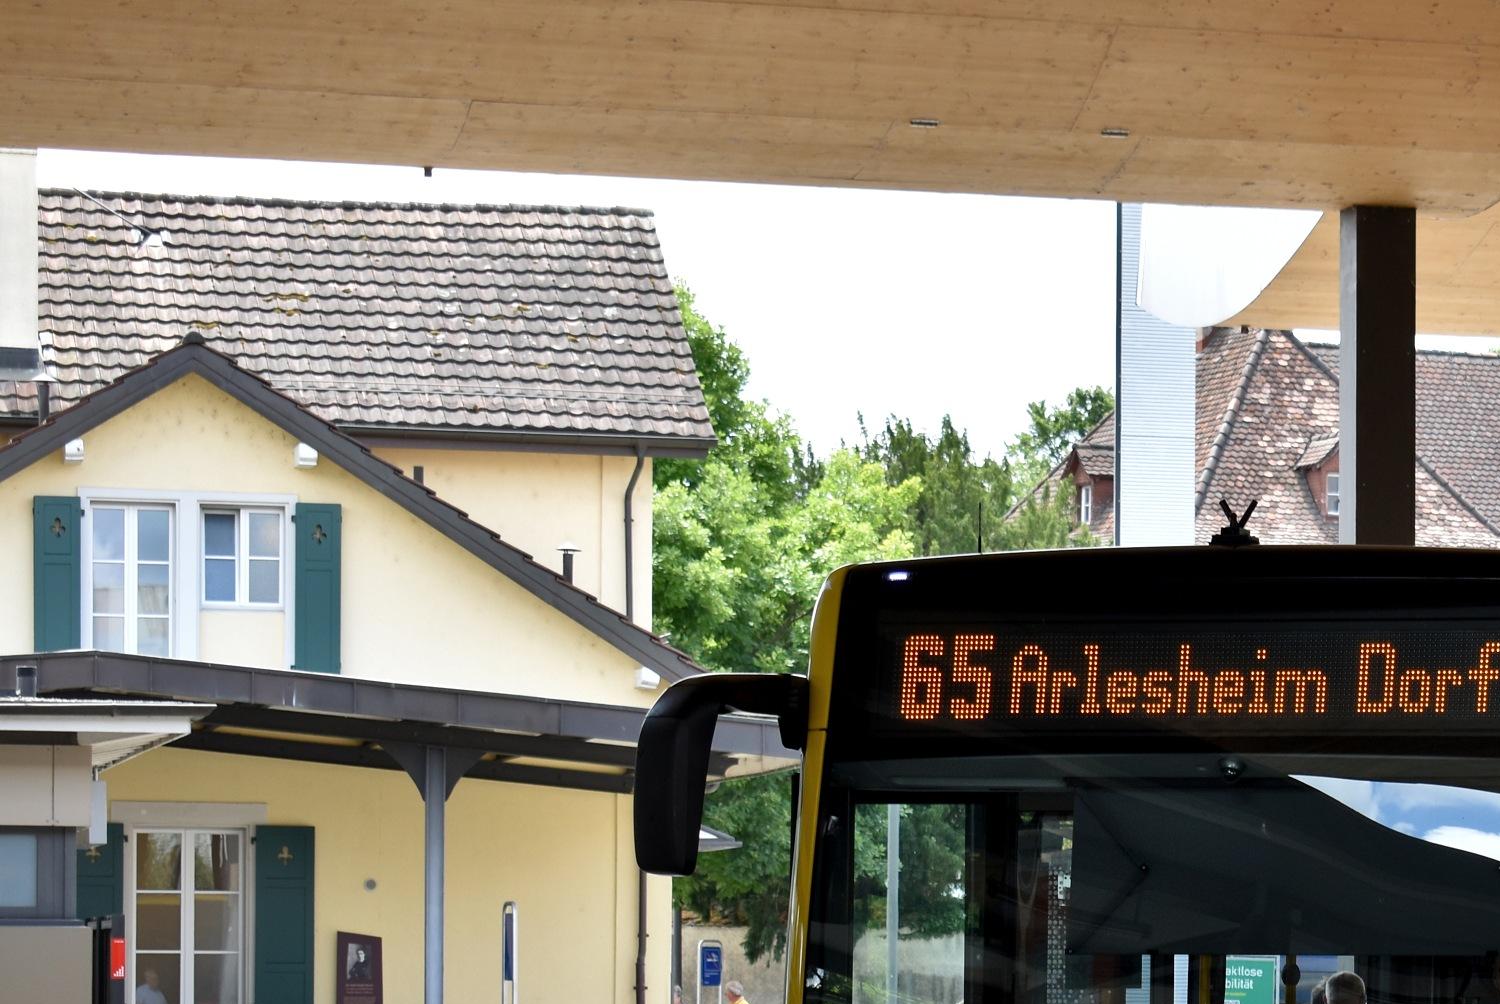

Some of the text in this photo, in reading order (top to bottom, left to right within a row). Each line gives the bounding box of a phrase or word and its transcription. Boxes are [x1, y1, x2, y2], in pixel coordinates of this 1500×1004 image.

[900, 635, 994, 719] 65
[1008, 644, 1326, 714] Arlesheim
[1225, 965, 1263, 977] aktlose
[1225, 978, 1254, 989] bilität
